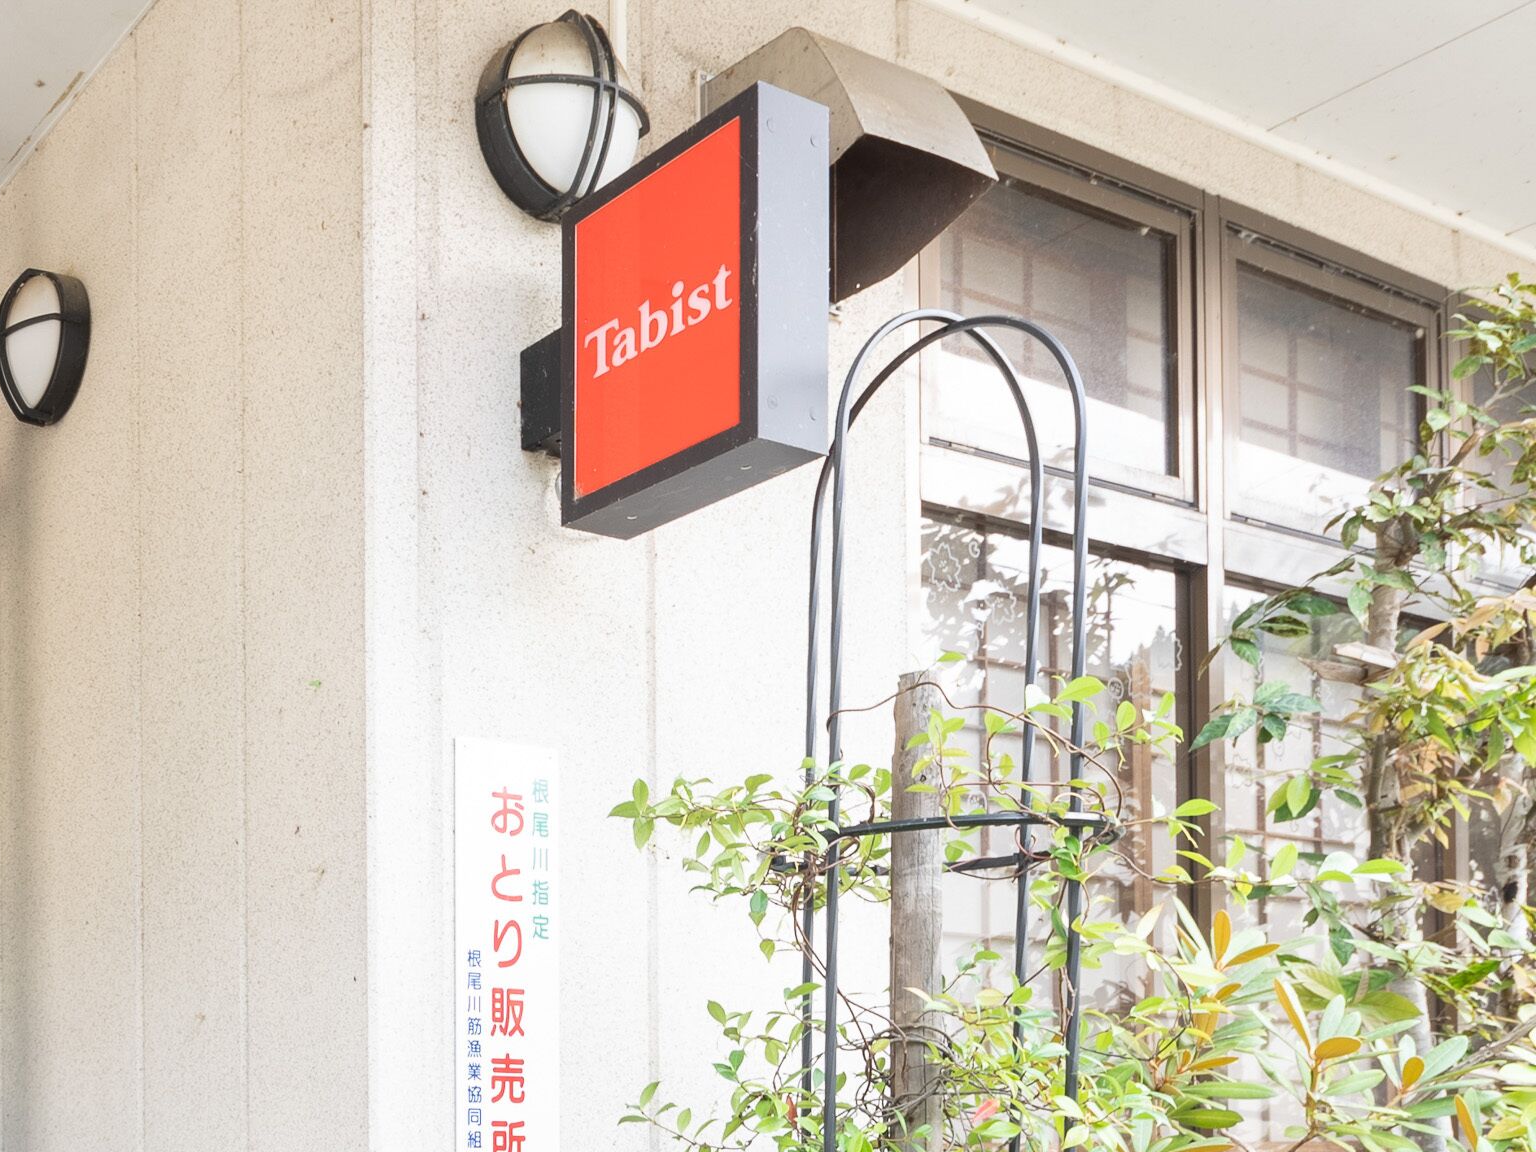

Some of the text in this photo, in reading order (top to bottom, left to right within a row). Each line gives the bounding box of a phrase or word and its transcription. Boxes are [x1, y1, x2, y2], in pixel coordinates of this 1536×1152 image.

[583, 263, 733, 379] Tabist
[531, 778, 550, 940] 根尾川指定
